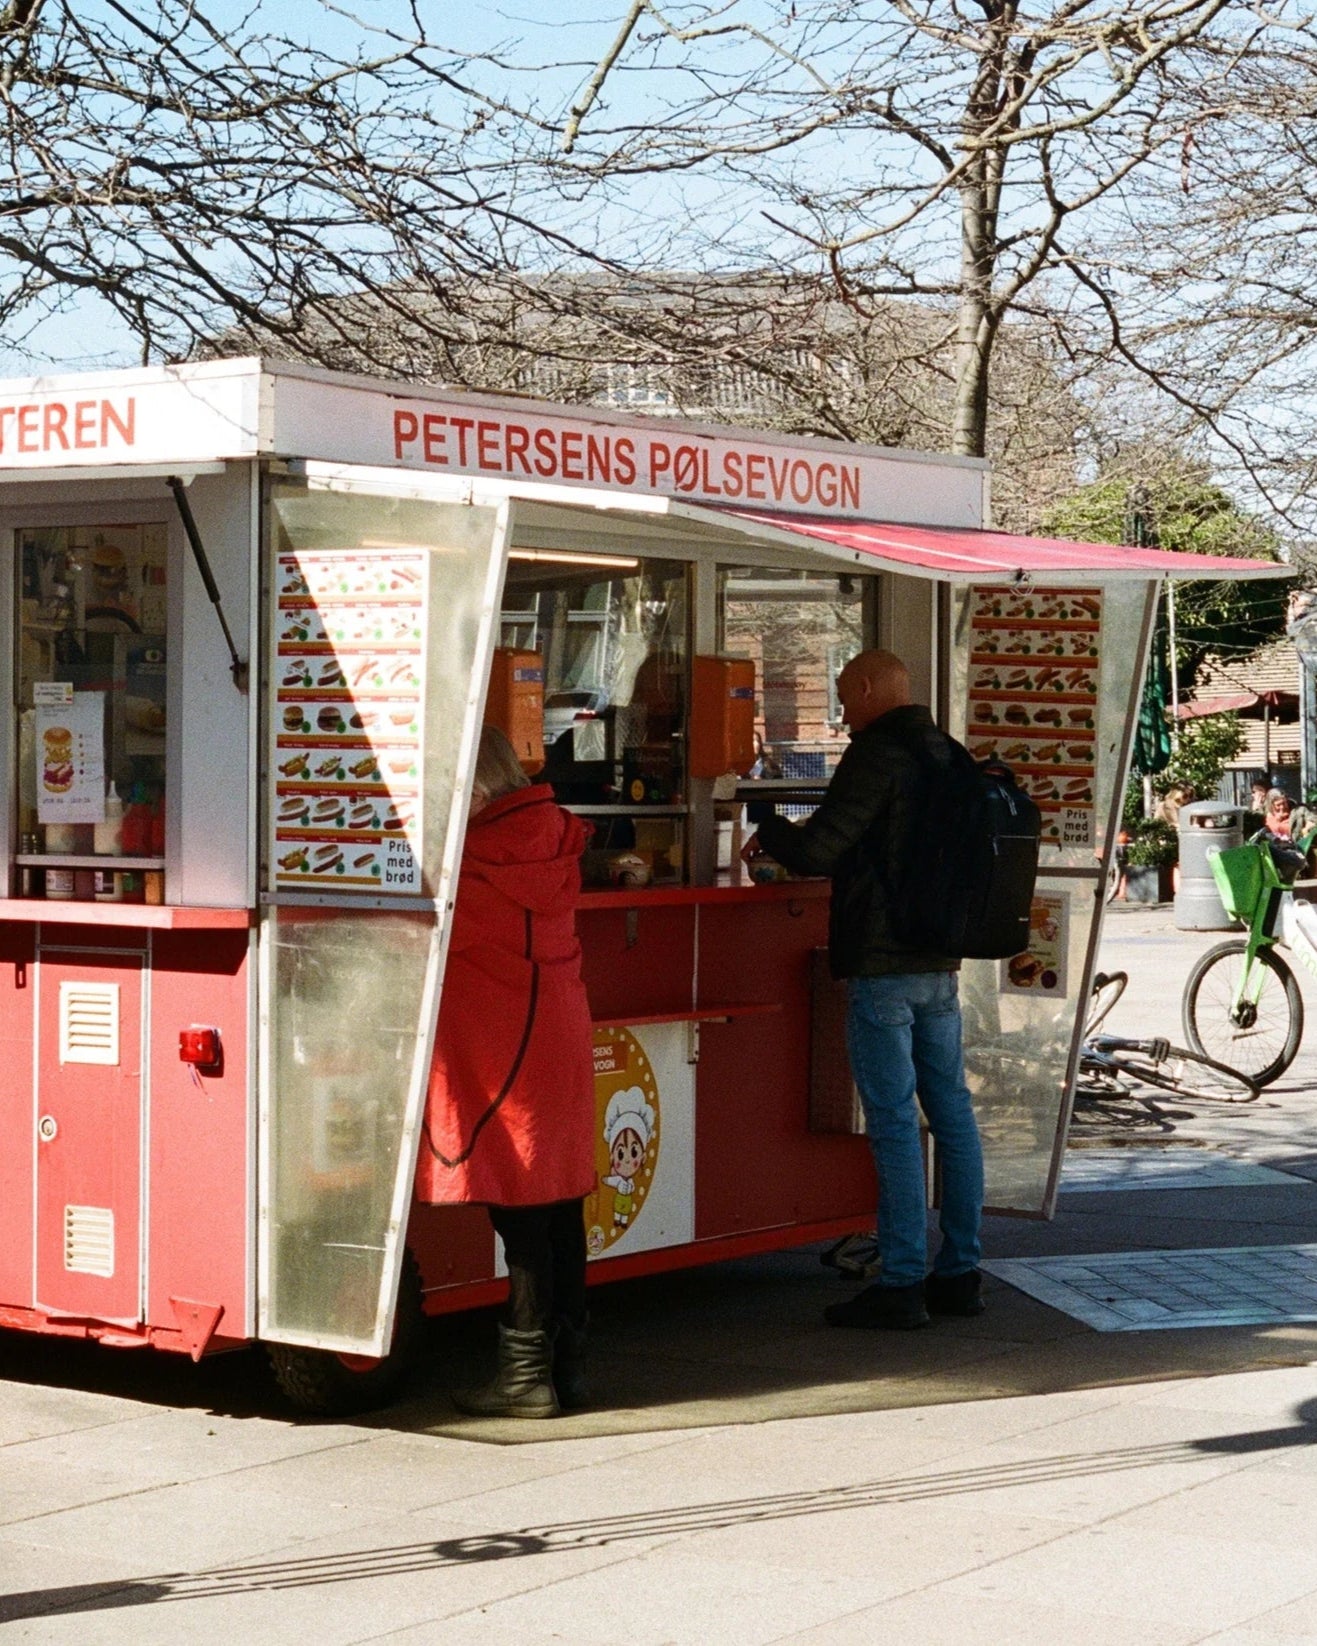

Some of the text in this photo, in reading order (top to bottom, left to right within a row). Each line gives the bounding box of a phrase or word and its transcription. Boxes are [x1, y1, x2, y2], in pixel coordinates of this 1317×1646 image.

[394, 408, 861, 509] PETERSENS PØLSEVOGN
[1066, 809, 1088, 819] Pris
[1064, 821, 1088, 831] med
[1063, 831, 1089, 842] brød
[389, 840, 412, 852] Pris
[387, 856, 413, 868] med
[386, 870, 414, 884] brød
